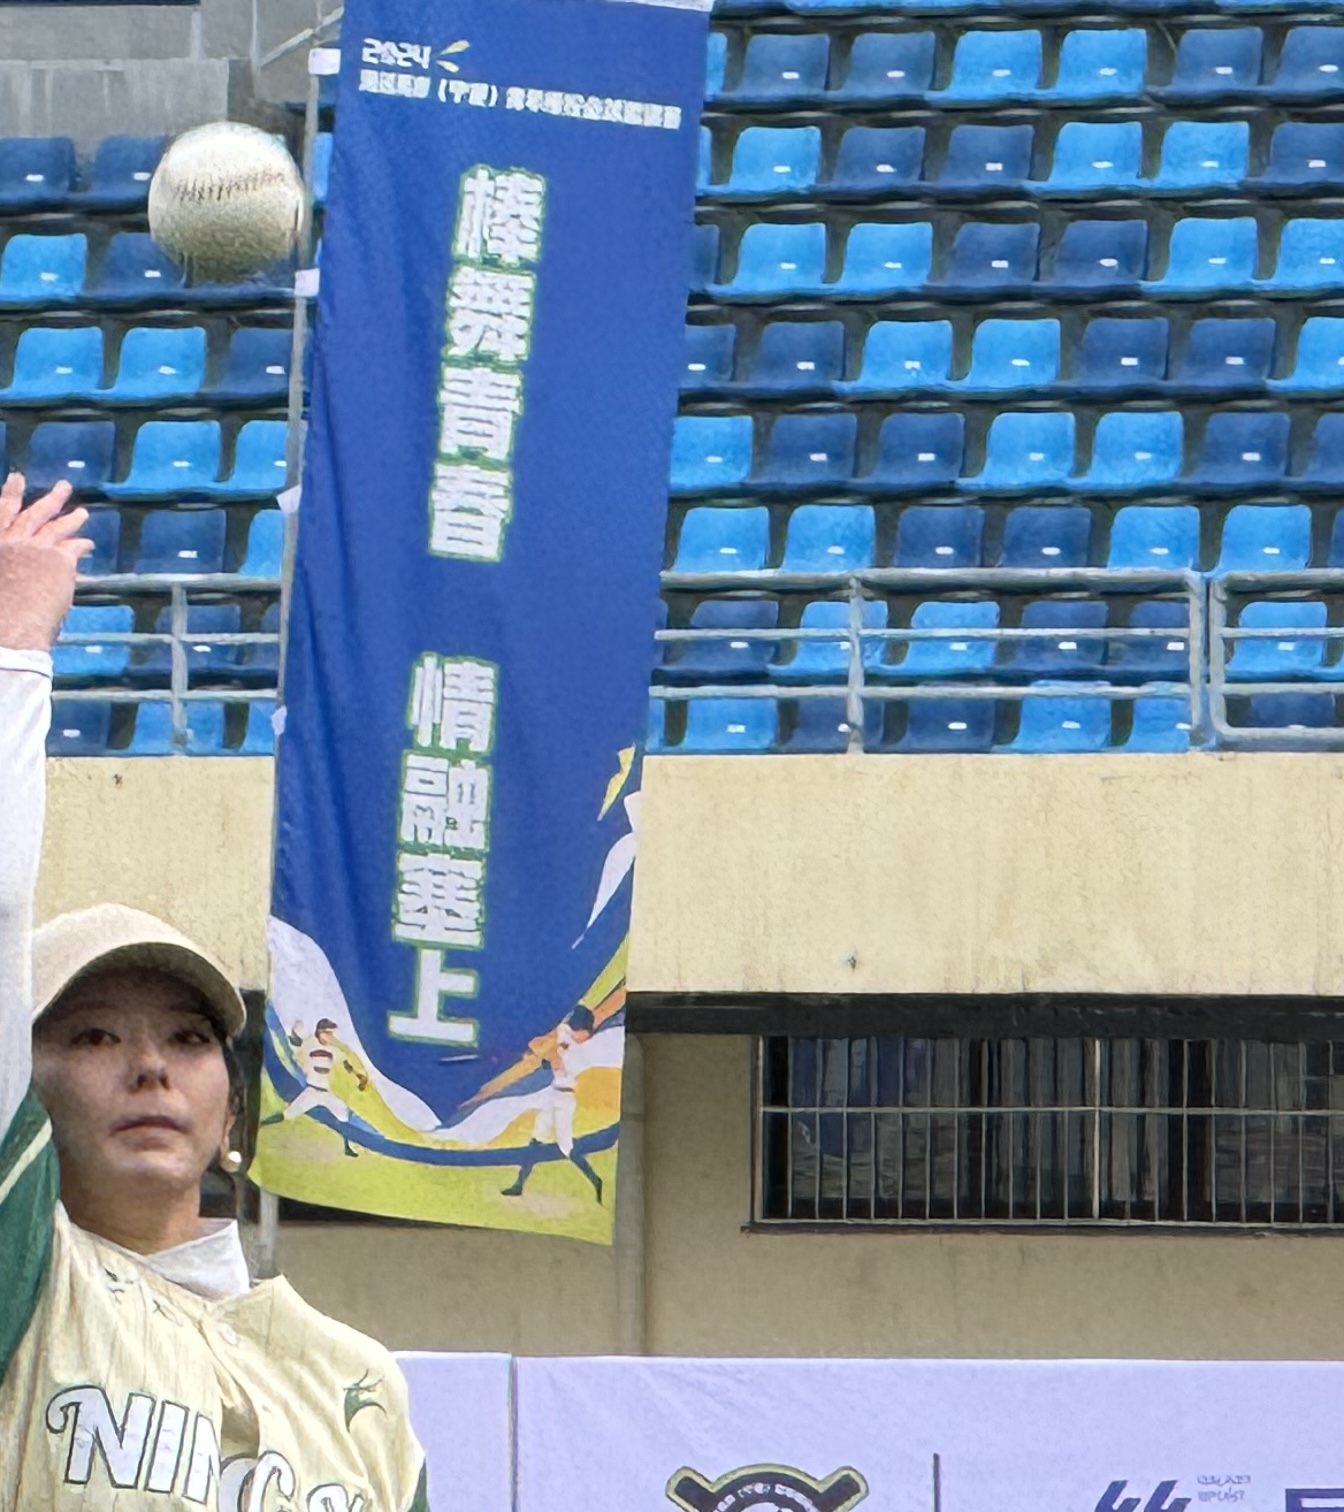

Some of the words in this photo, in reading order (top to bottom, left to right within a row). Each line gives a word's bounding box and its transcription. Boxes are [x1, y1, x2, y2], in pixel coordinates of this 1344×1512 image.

[429, 166, 544, 561] 棒舞青春
[388, 652, 498, 1046] 情融塞上
